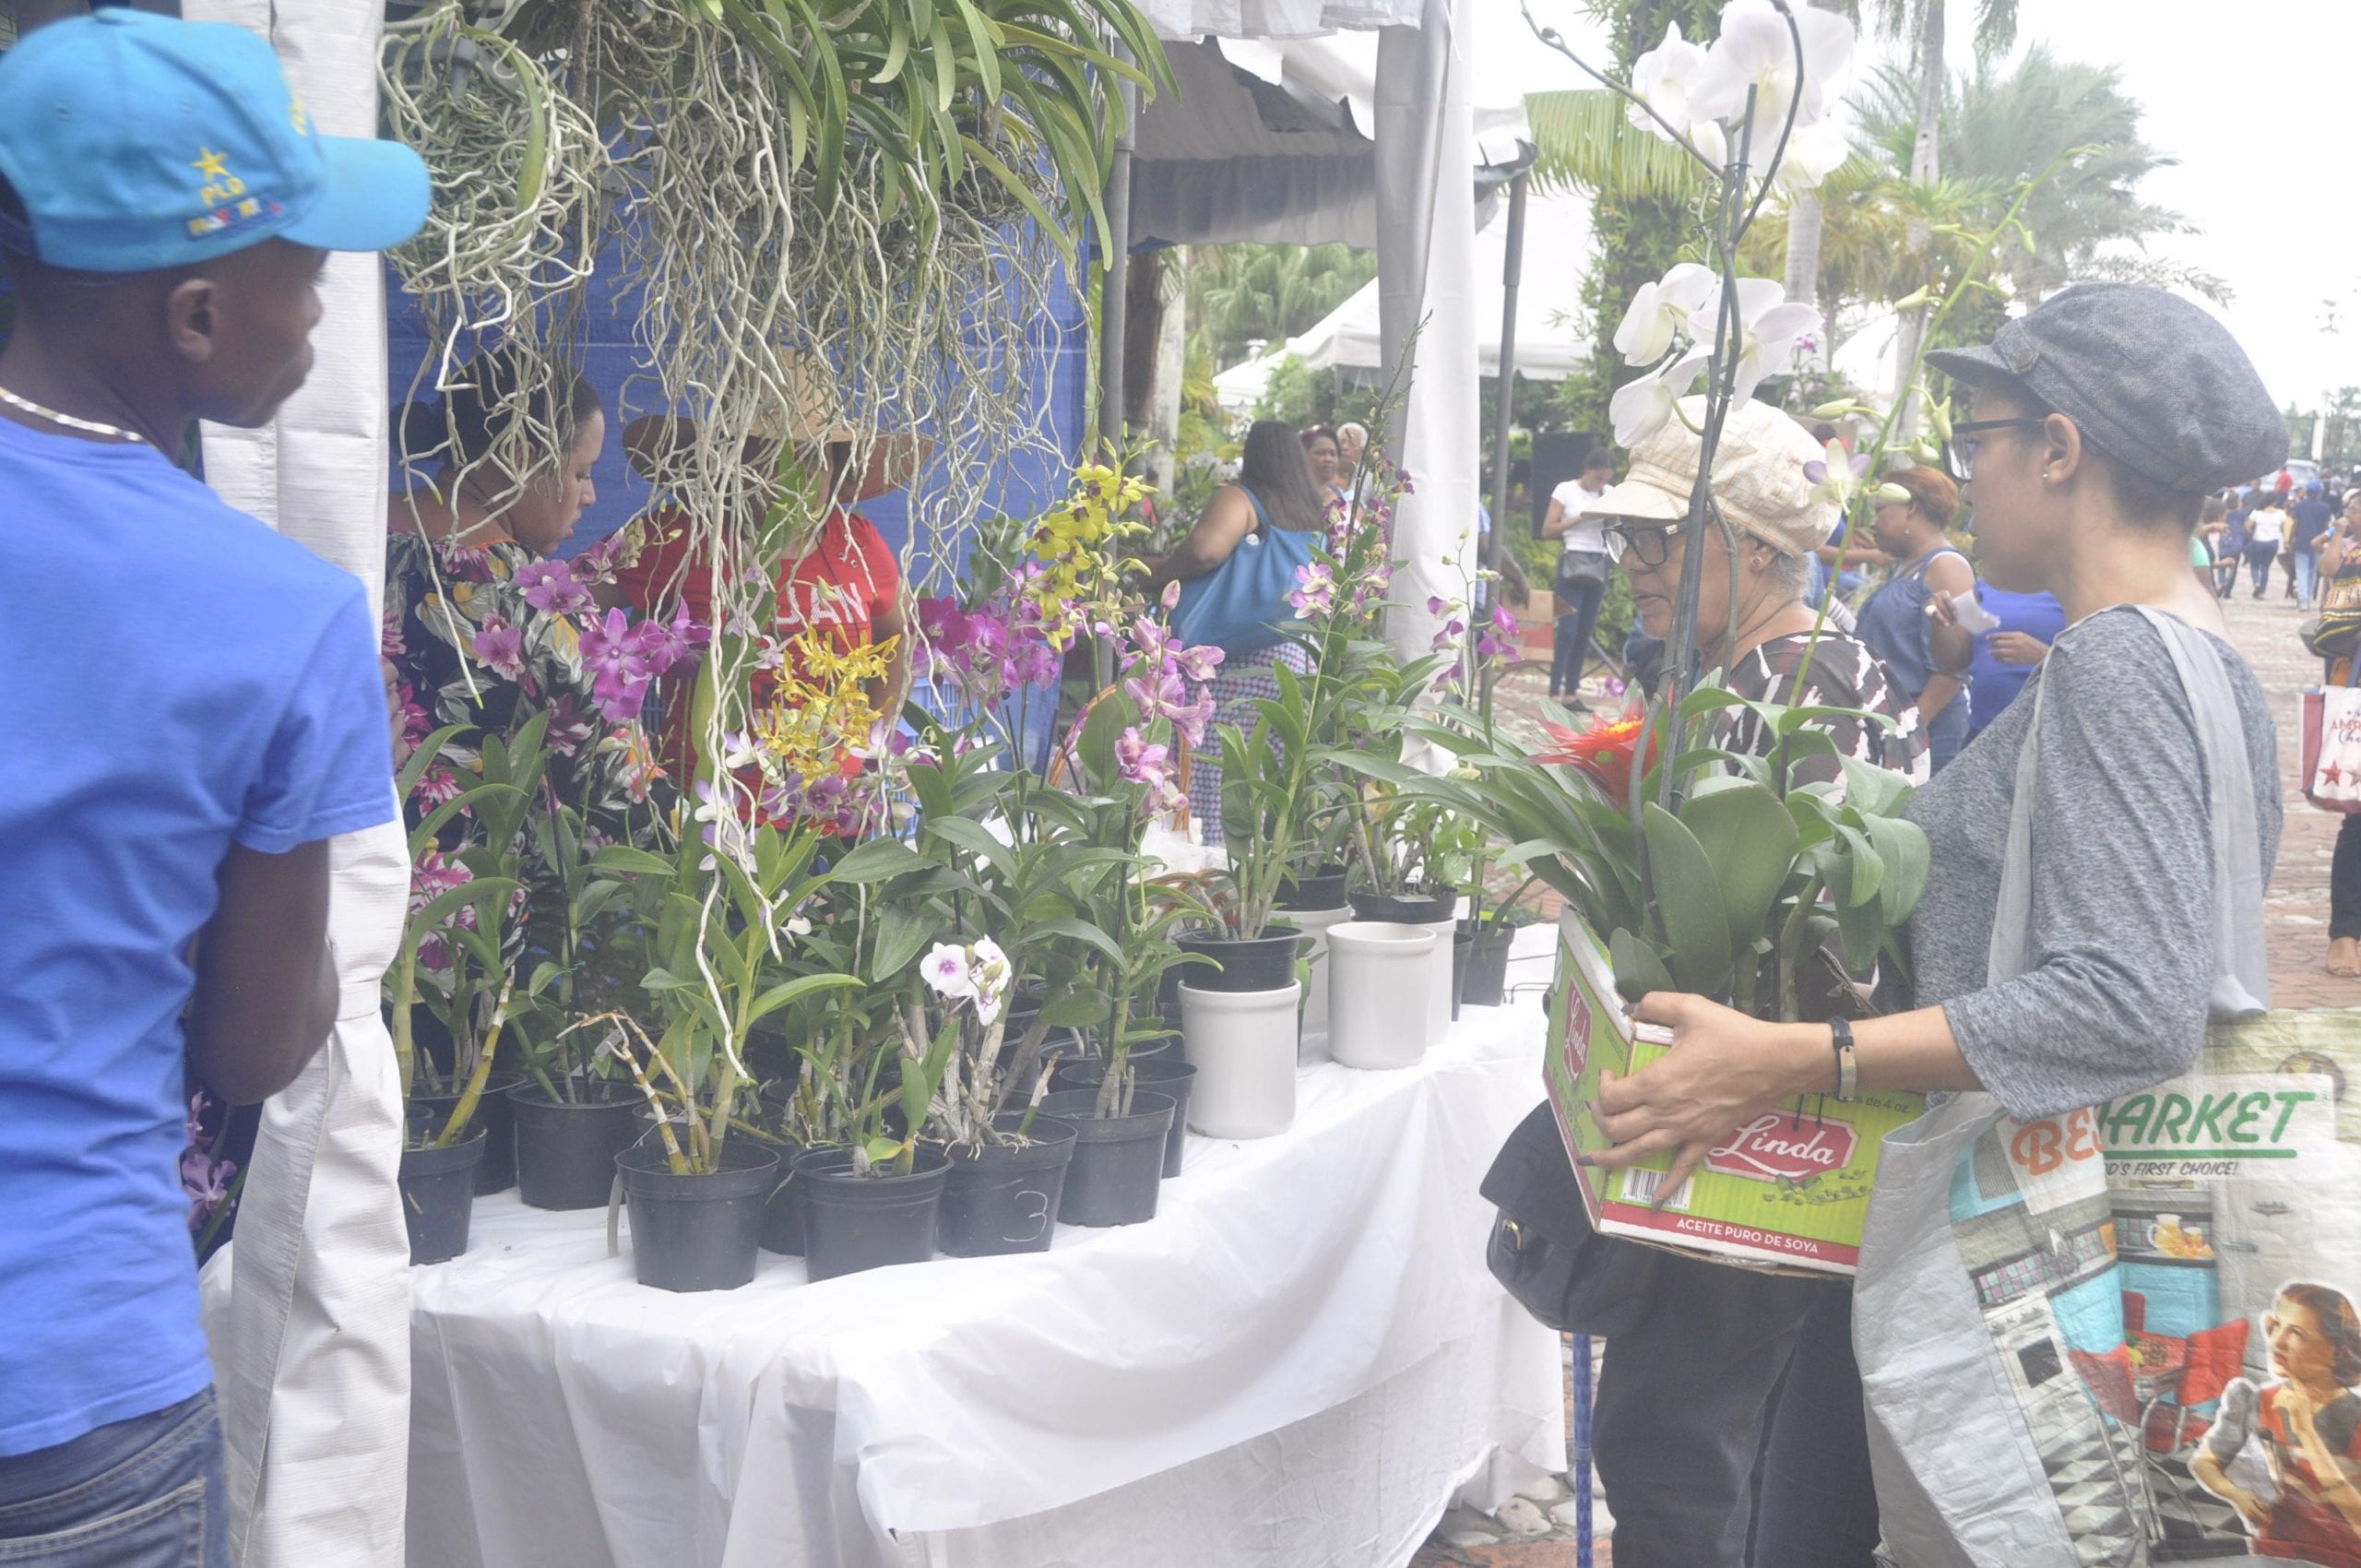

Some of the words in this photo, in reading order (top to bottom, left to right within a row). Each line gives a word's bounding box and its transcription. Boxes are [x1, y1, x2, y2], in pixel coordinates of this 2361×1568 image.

[1866, 1096, 1881, 1108] de
[1708, 1115, 1835, 1178] Linda
[2133, 1162, 2177, 1175] FIRST
[2179, 1161, 2238, 1176] CHOICE!
[1003, 1190, 1049, 1242] 3
[1676, 1218, 1722, 1236] ACEITE
[1725, 1225, 1762, 1243] PURO
[1764, 1234, 1782, 1247] DE
[1784, 1238, 1819, 1254] SOYA
